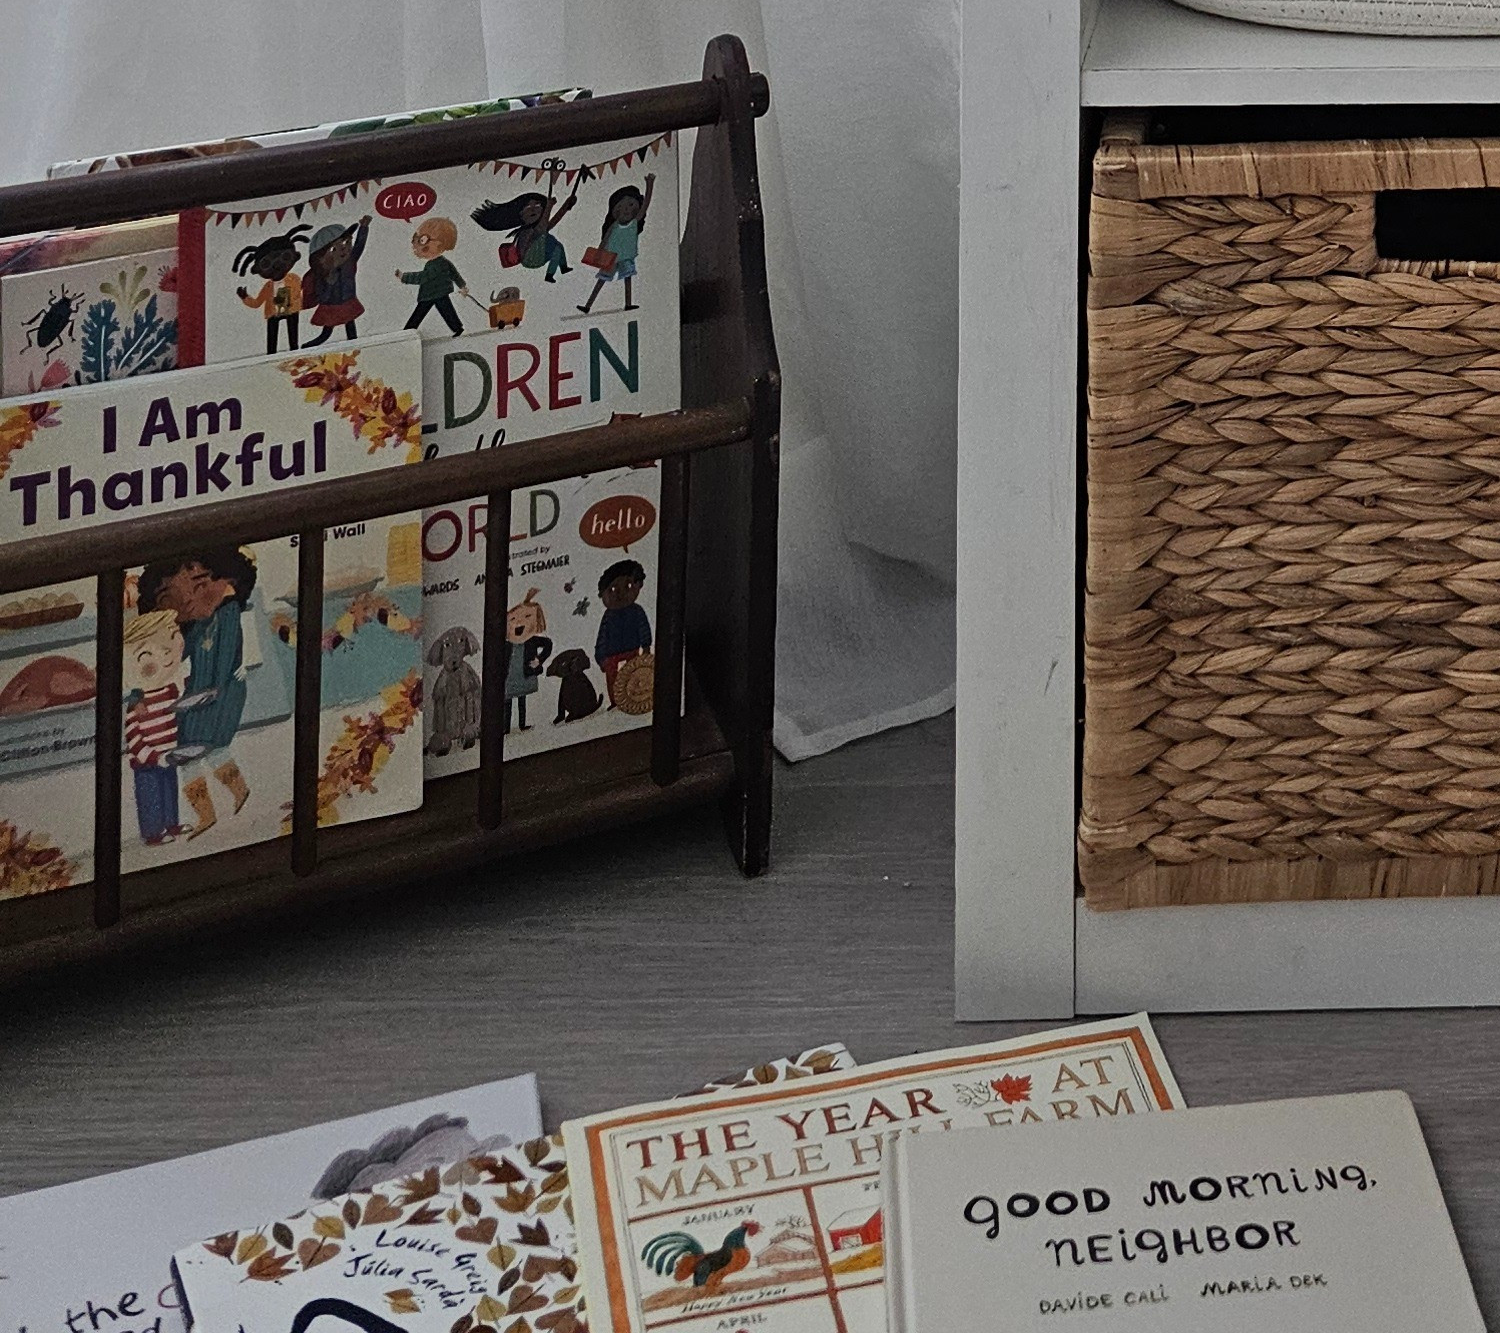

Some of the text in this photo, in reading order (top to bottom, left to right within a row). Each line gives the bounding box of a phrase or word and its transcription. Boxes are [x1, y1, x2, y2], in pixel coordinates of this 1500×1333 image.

[383, 193, 427, 209] CIAO
[102, 396, 243, 454] I Am
[9, 419, 328, 527] Thankful
[333, 523, 366, 540] Wall
[591, 507, 646, 536] hello
[540, 545, 551, 555] by
[520, 554, 570, 576] STEGMAIER
[422, 578, 460, 597] WARDS
[626, 1054, 1115, 1170] THE YEAR AT
[634, 1142, 831, 1209] MAPLE
[375, 1229, 450, 1258] Louise
[1289, 1272, 1328, 1290] DEK
[65, 1291, 146, 1333] the
[716, 1312, 768, 1331] APRIL
